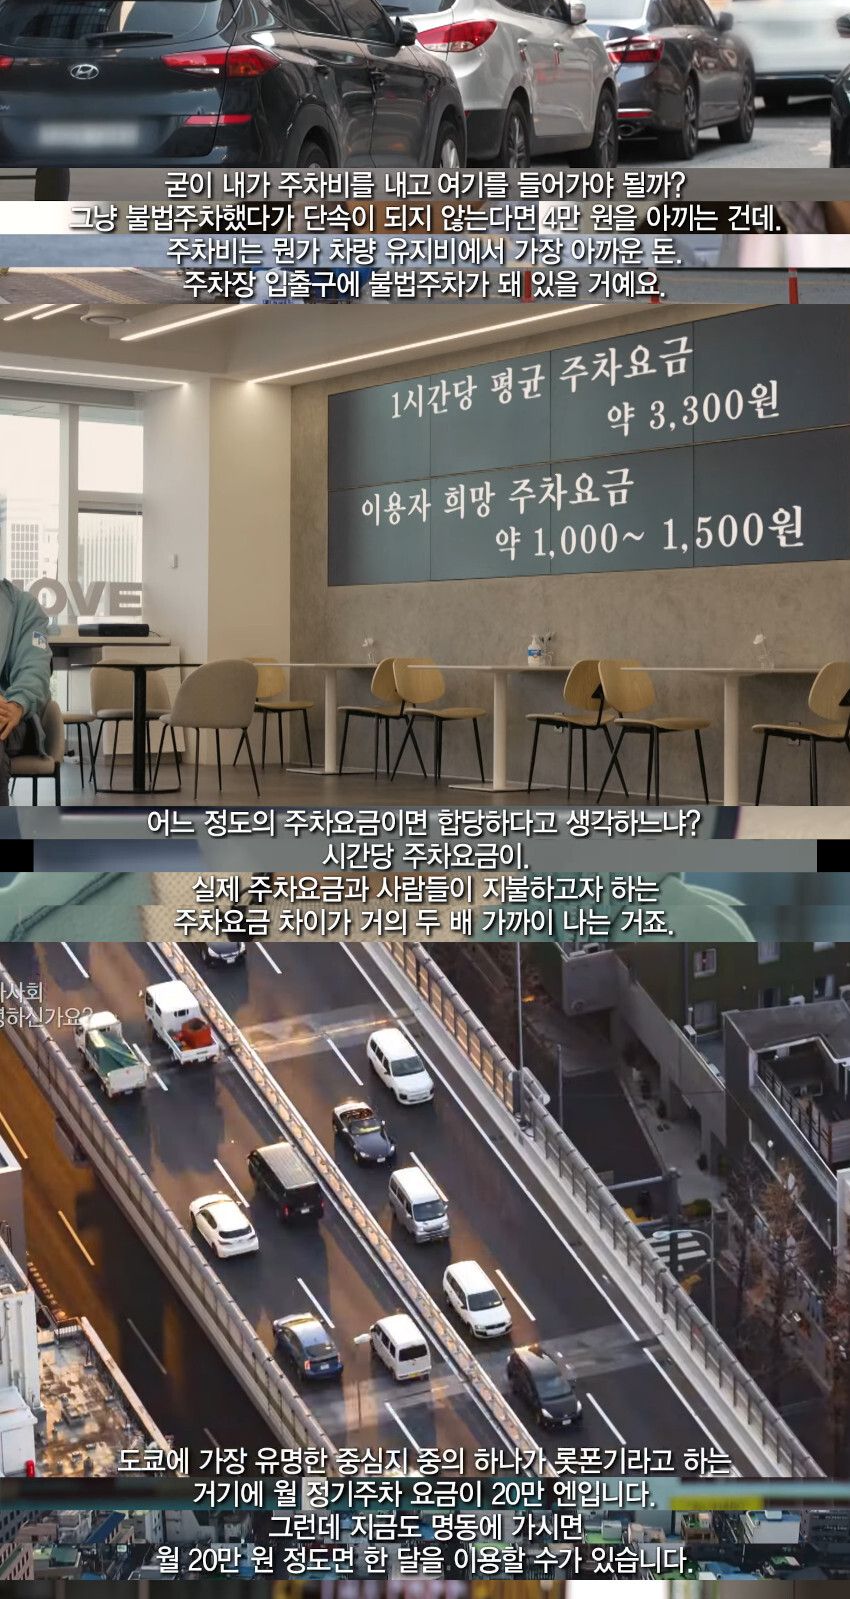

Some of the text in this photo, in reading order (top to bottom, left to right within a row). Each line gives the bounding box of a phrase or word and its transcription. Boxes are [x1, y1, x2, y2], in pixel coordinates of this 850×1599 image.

[391, 336, 693, 419] 1시간당 평균 주차요금
[607, 379, 781, 438] 약 3,300원
[361, 467, 635, 527] 이용자 희망 주차요금
[495, 504, 804, 562] 약 1,000~ 1,500원
